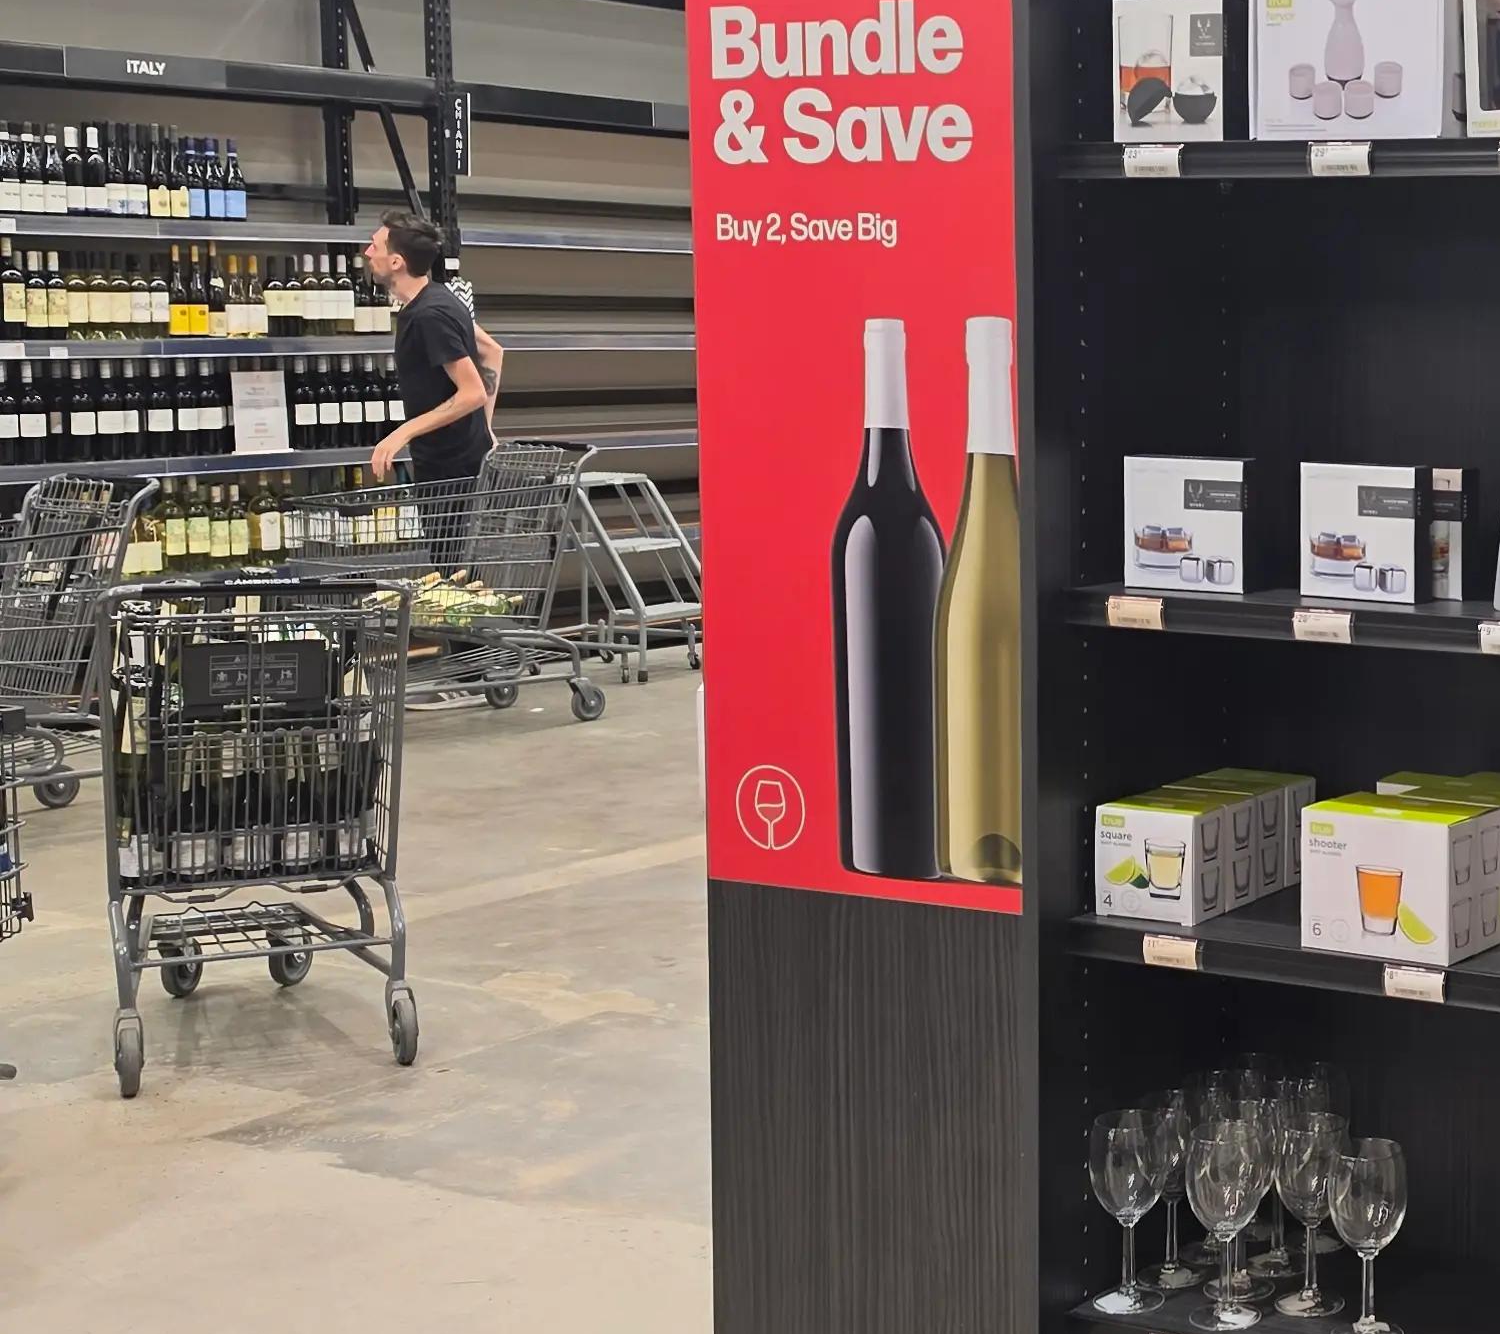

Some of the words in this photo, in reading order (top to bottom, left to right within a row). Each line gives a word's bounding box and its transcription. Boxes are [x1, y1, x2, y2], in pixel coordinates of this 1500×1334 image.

[126, 59, 166, 76] ITALY
[454, 98, 464, 170] CHIANTI
[712, 89, 768, 165] &
[783, 87, 973, 162] Save
[715, 213, 762, 246] Buy
[766, 213, 786, 245] 2,
[790, 212, 852, 241] Save
[857, 213, 898, 248] Big
[1100, 830, 1133, 842] square
[1309, 837, 1347, 850] shooter
[1103, 893, 1113, 908] 4
[1312, 922, 1322, 936] 6
